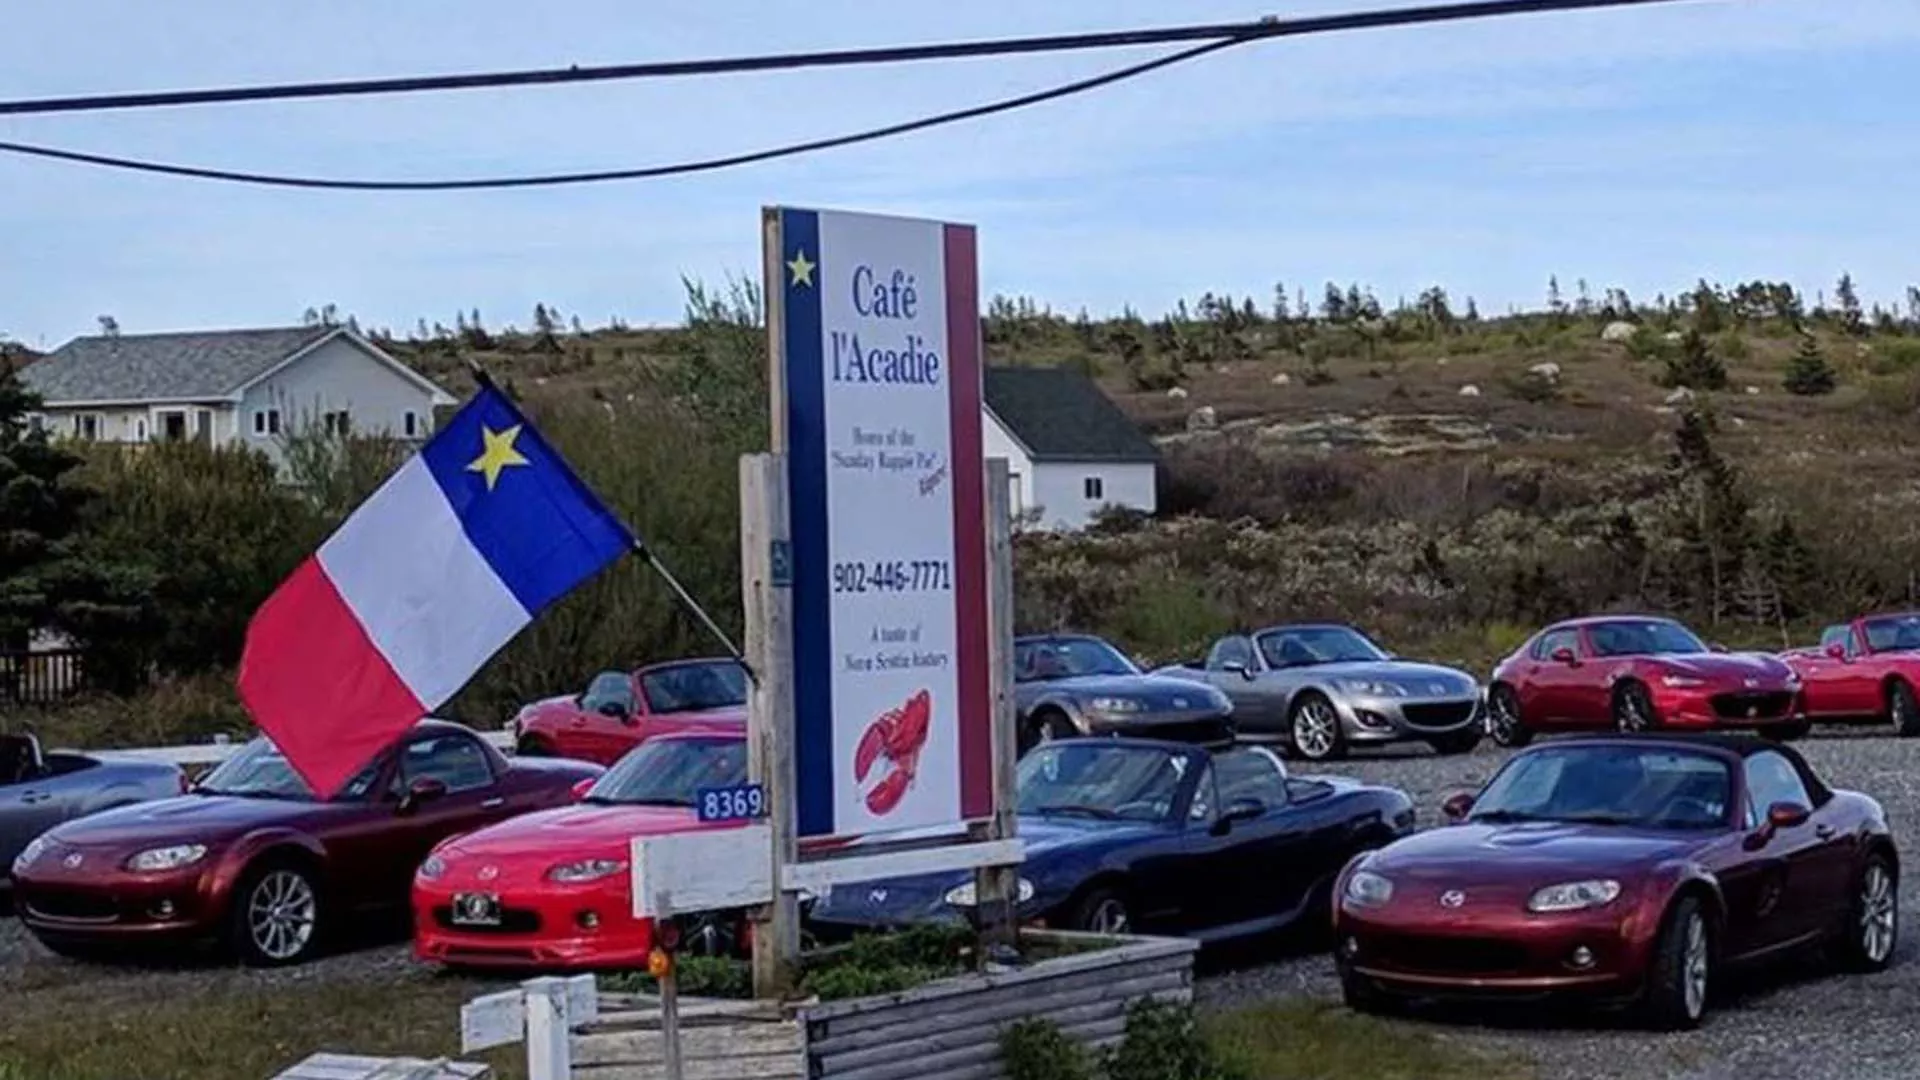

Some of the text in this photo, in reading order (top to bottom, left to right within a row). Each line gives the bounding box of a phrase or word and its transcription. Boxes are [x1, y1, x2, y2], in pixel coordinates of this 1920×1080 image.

[852, 264, 918, 320] Café
[831, 330, 940, 386] l'Acadie
[833, 560, 951, 593] 902-446-7771
[704, 788, 761, 819] 8369
